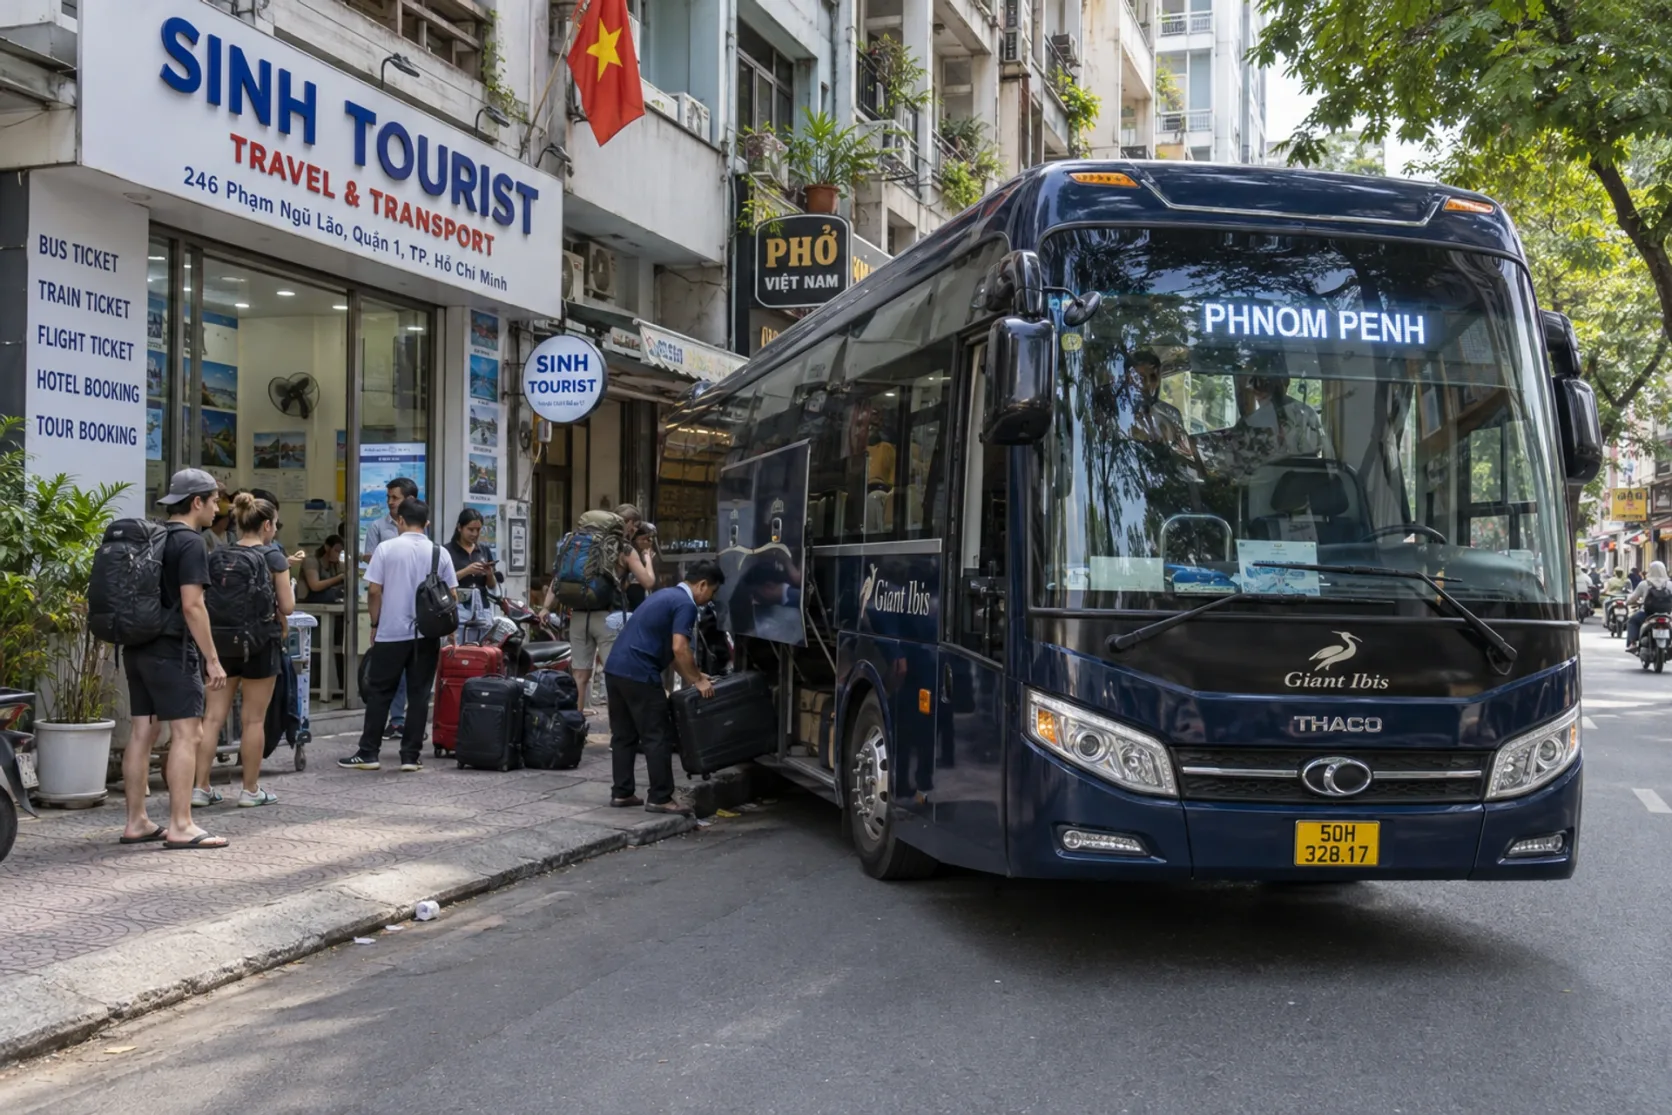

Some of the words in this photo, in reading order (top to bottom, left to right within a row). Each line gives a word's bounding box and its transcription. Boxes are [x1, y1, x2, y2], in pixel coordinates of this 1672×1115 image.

[159, 16, 317, 145] SINH
[344, 100, 539, 235] TOURIST
[230, 133, 336, 199] TRAVEL
[344, 180, 361, 208] &
[369, 188, 495, 257] TRANSPORT
[183, 166, 219, 194] 246
[226, 180, 274, 213] Phạm
[280, 199, 311, 227] Ngũ
[317, 212, 348, 241] Lão,
[393, 240, 405, 259] 1,
[409, 245, 430, 266] TP.
[480, 269, 507, 291] Minh
[765, 223, 838, 268] PHỞ
[39, 234, 68, 260] BUS
[72, 243, 119, 273] TICKET
[38, 280, 82, 308] TRAIN
[86, 292, 130, 319] TICKET
[764, 273, 799, 293] VIỆT
[804, 274, 839, 289] NAM
[1203, 303, 1328, 339] PHNOM
[1339, 310, 1425, 345] PENH
[38, 324, 86, 353] FLIGHT
[90, 335, 134, 361] TICKET
[536, 354, 588, 373] SINH
[36, 368, 80, 395] HOTEL
[84, 377, 140, 404] BOOKING
[528, 379, 597, 394] TOURIST
[36, 414, 74, 440] TOUR
[79, 421, 137, 447] BOOKING
[874, 579, 906, 614] Giant
[907, 580, 930, 616] Ibis
[1284, 671, 1345, 690] Giant
[1351, 672, 1390, 690] Ibis
[1294, 716, 1383, 733] THACO
[1320, 824, 1356, 843] 50H
[1305, 845, 1369, 863] 328.17
